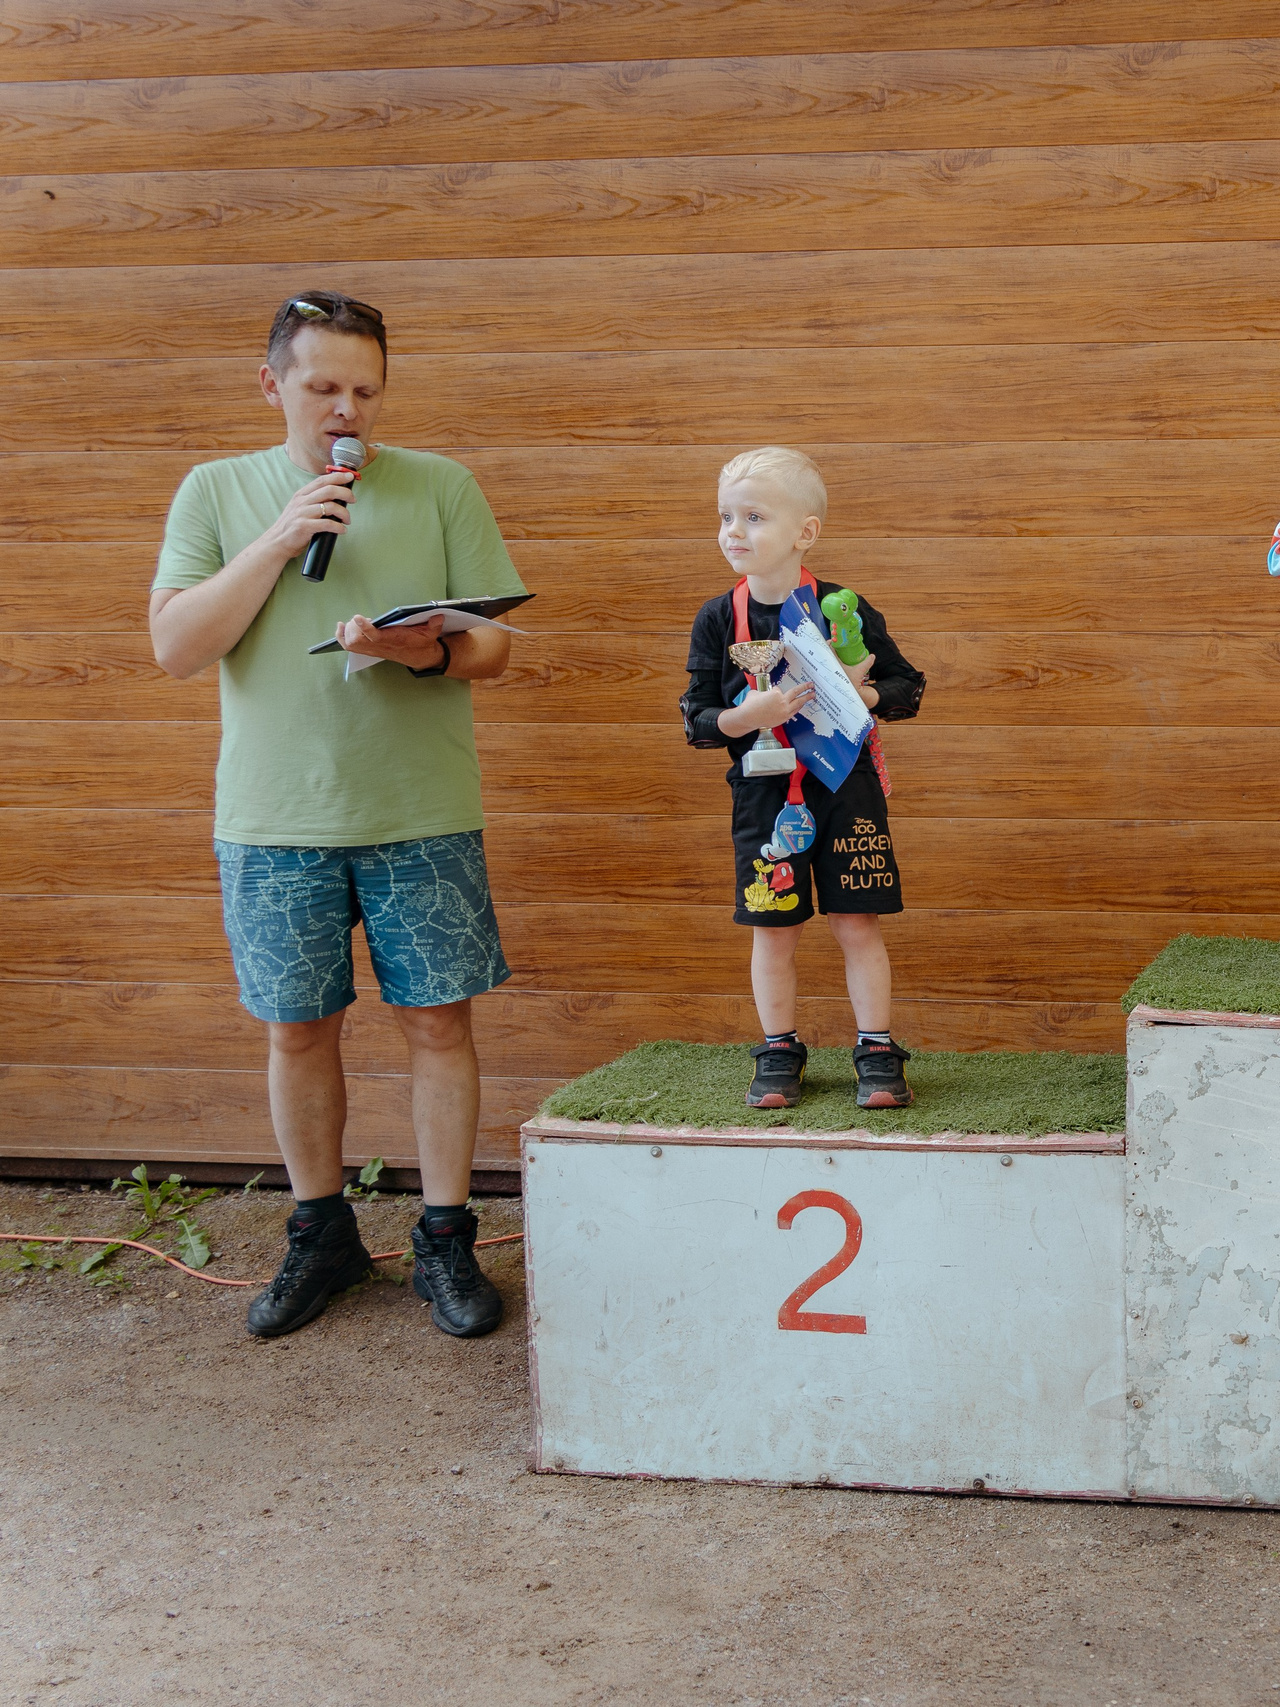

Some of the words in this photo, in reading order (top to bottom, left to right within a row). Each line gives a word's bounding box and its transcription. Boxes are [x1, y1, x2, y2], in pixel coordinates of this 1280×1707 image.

[800, 813, 810, 828] 2
[852, 824, 877, 835] 100
[833, 834, 891, 853] MICKEY
[849, 854, 886, 871] AND
[840, 872, 893, 890] PLUTO
[777, 1188, 867, 1335] 2
